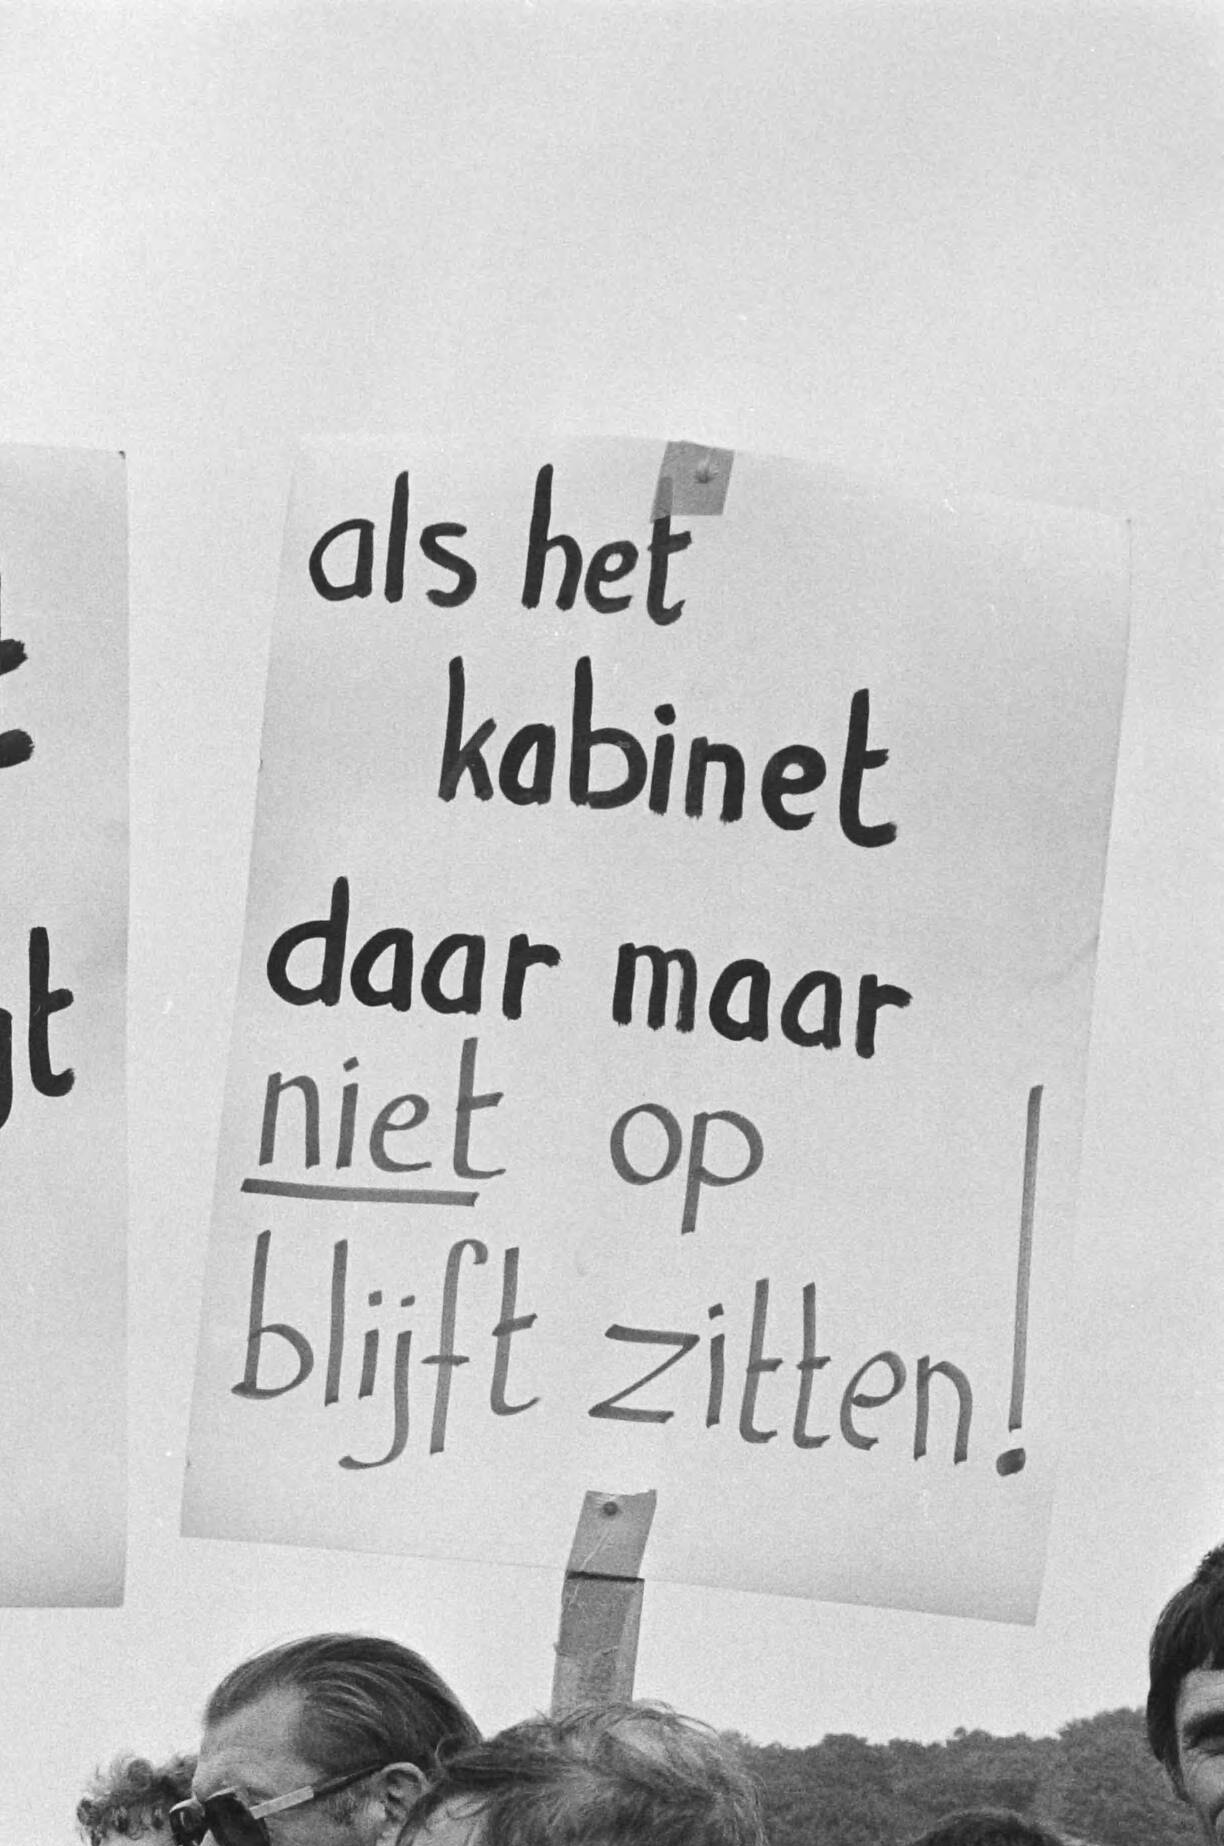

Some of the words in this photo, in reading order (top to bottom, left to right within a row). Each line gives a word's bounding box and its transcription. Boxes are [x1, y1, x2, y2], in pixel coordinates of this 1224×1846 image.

[307, 470, 479, 609] als
[521, 463, 693, 627] het
[437, 655, 899, 849] kabinet
[265, 875, 562, 1021] daar
[611, 941, 913, 1060] maar
[258, 1036, 508, 1182] niet
[608, 1101, 766, 1236] op
[230, 1229, 540, 1470] blijft
